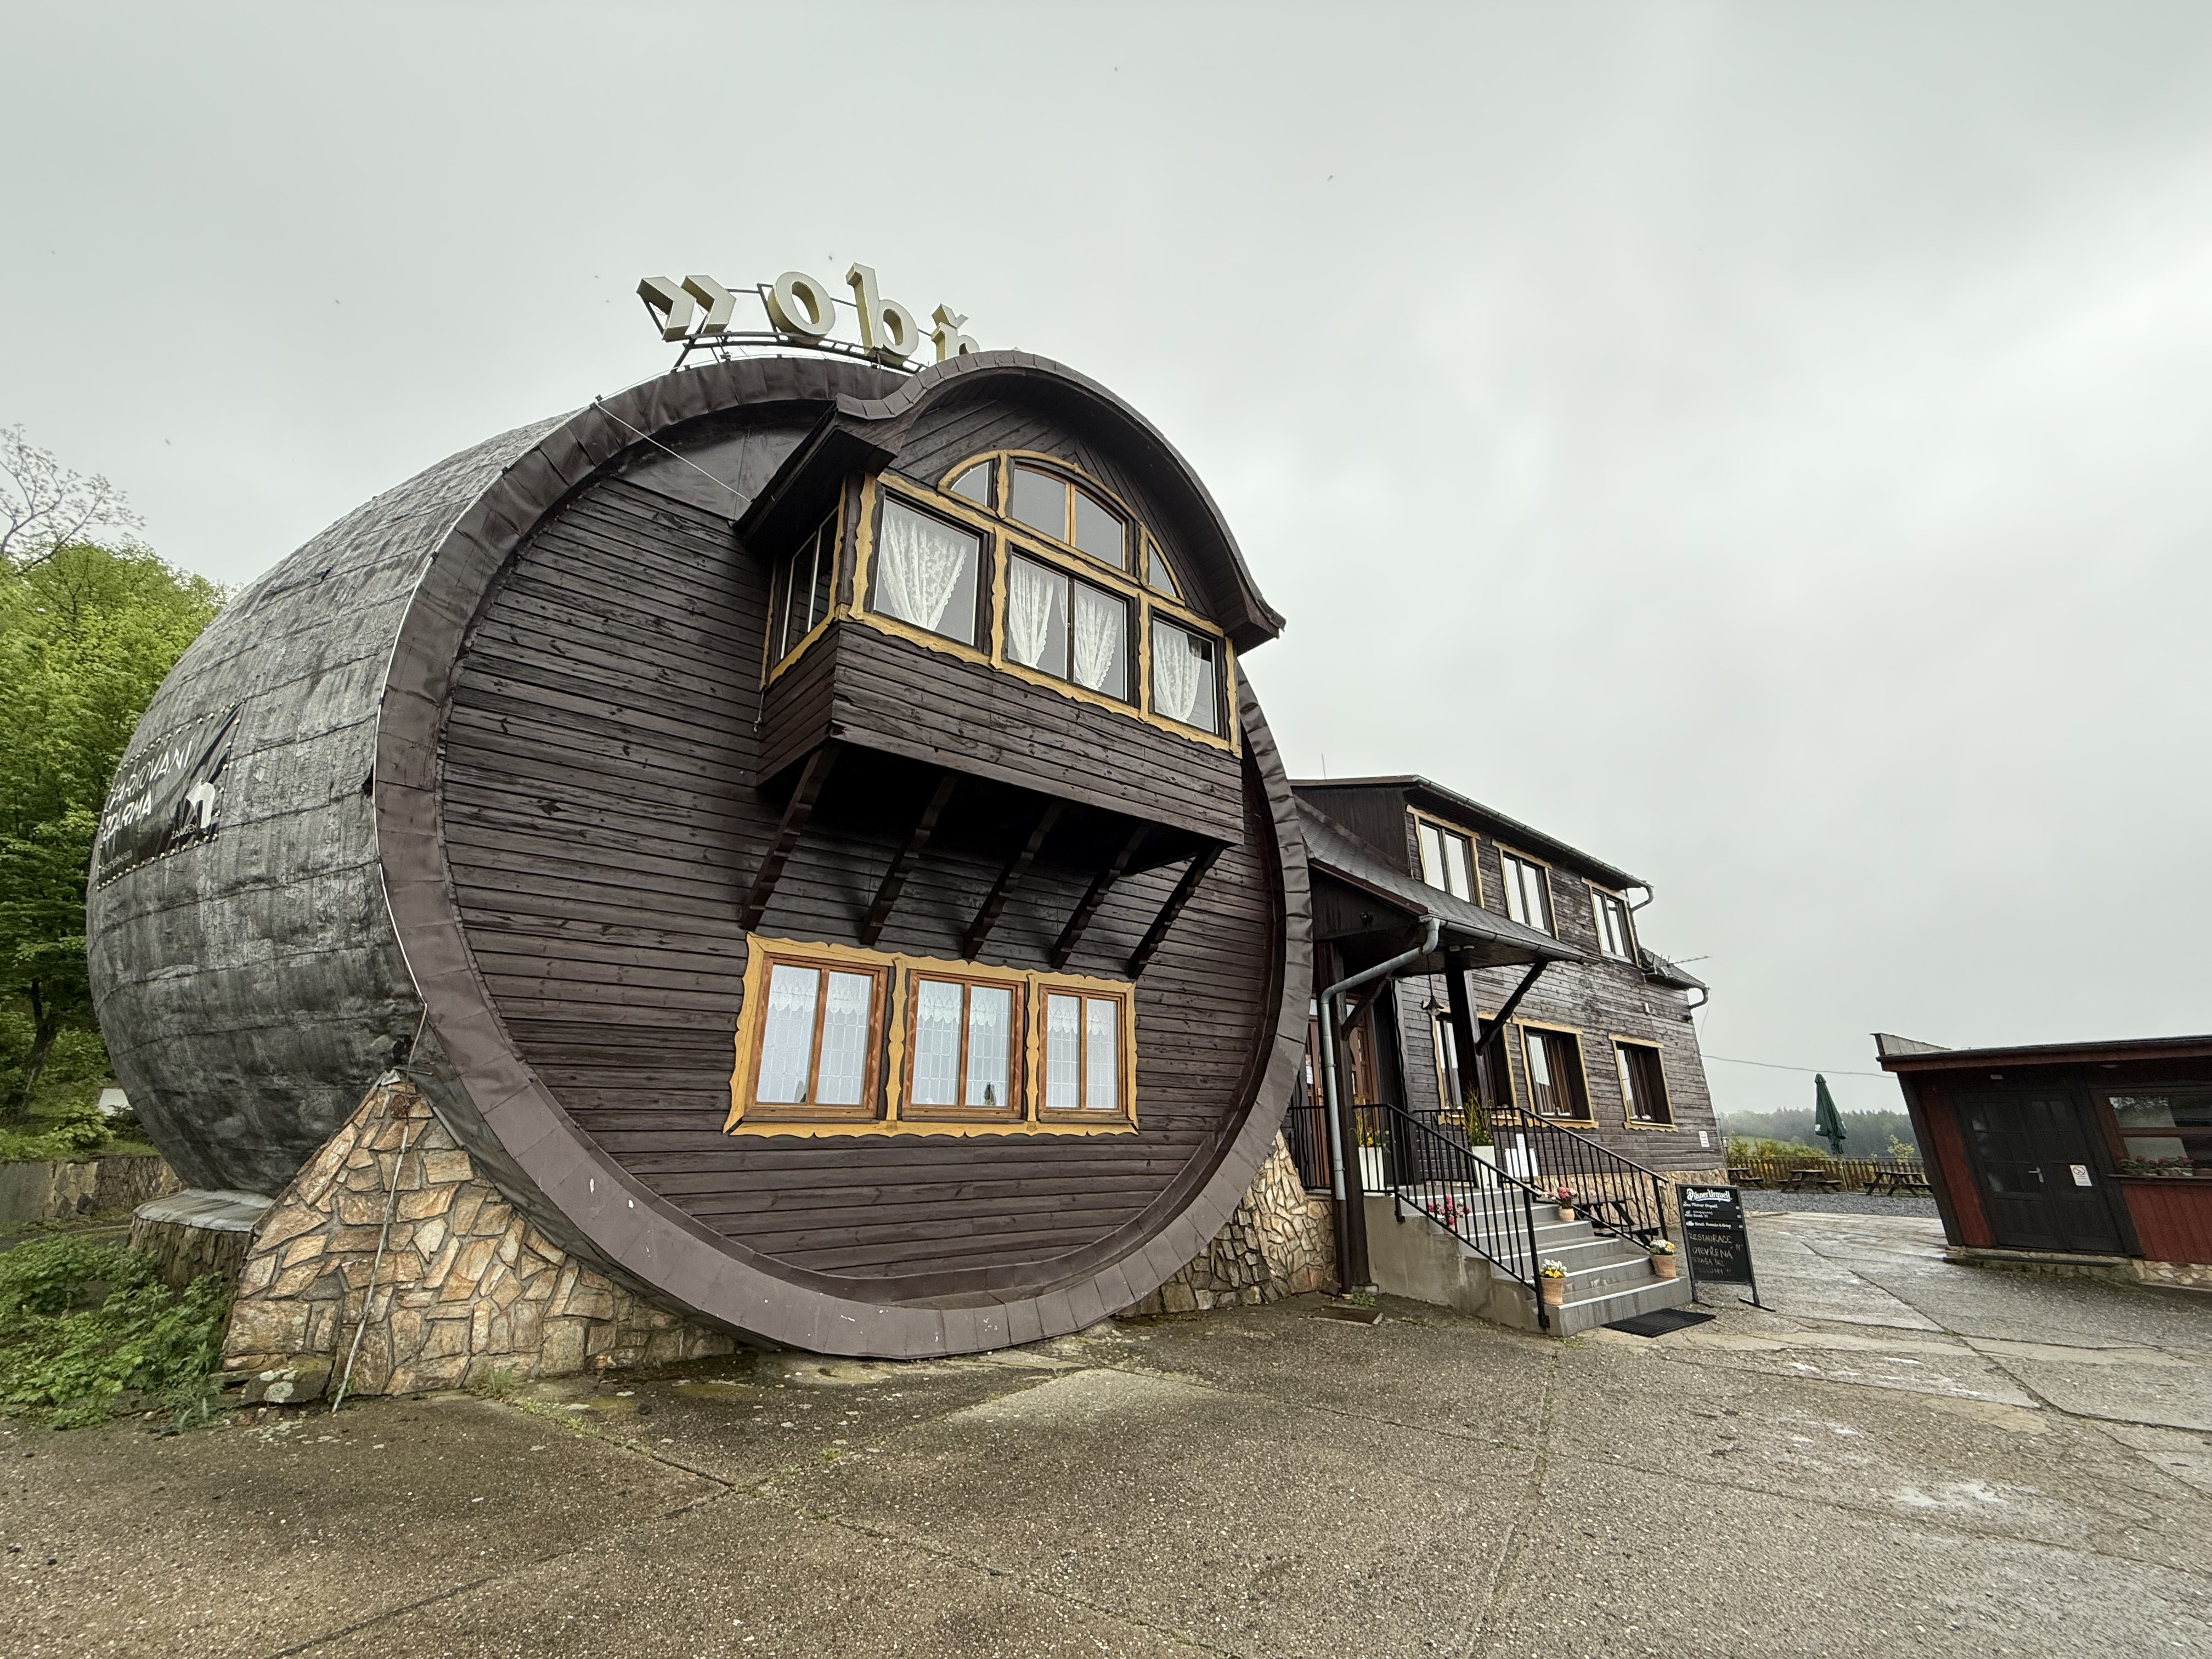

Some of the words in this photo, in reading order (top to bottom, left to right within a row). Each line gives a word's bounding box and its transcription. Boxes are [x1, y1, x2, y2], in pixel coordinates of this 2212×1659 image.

[1686, 1188, 1709, 1201] Pilsner
[1707, 1188, 1731, 1202] Urquell
[1688, 1232, 1732, 1244] RESTAURACE
